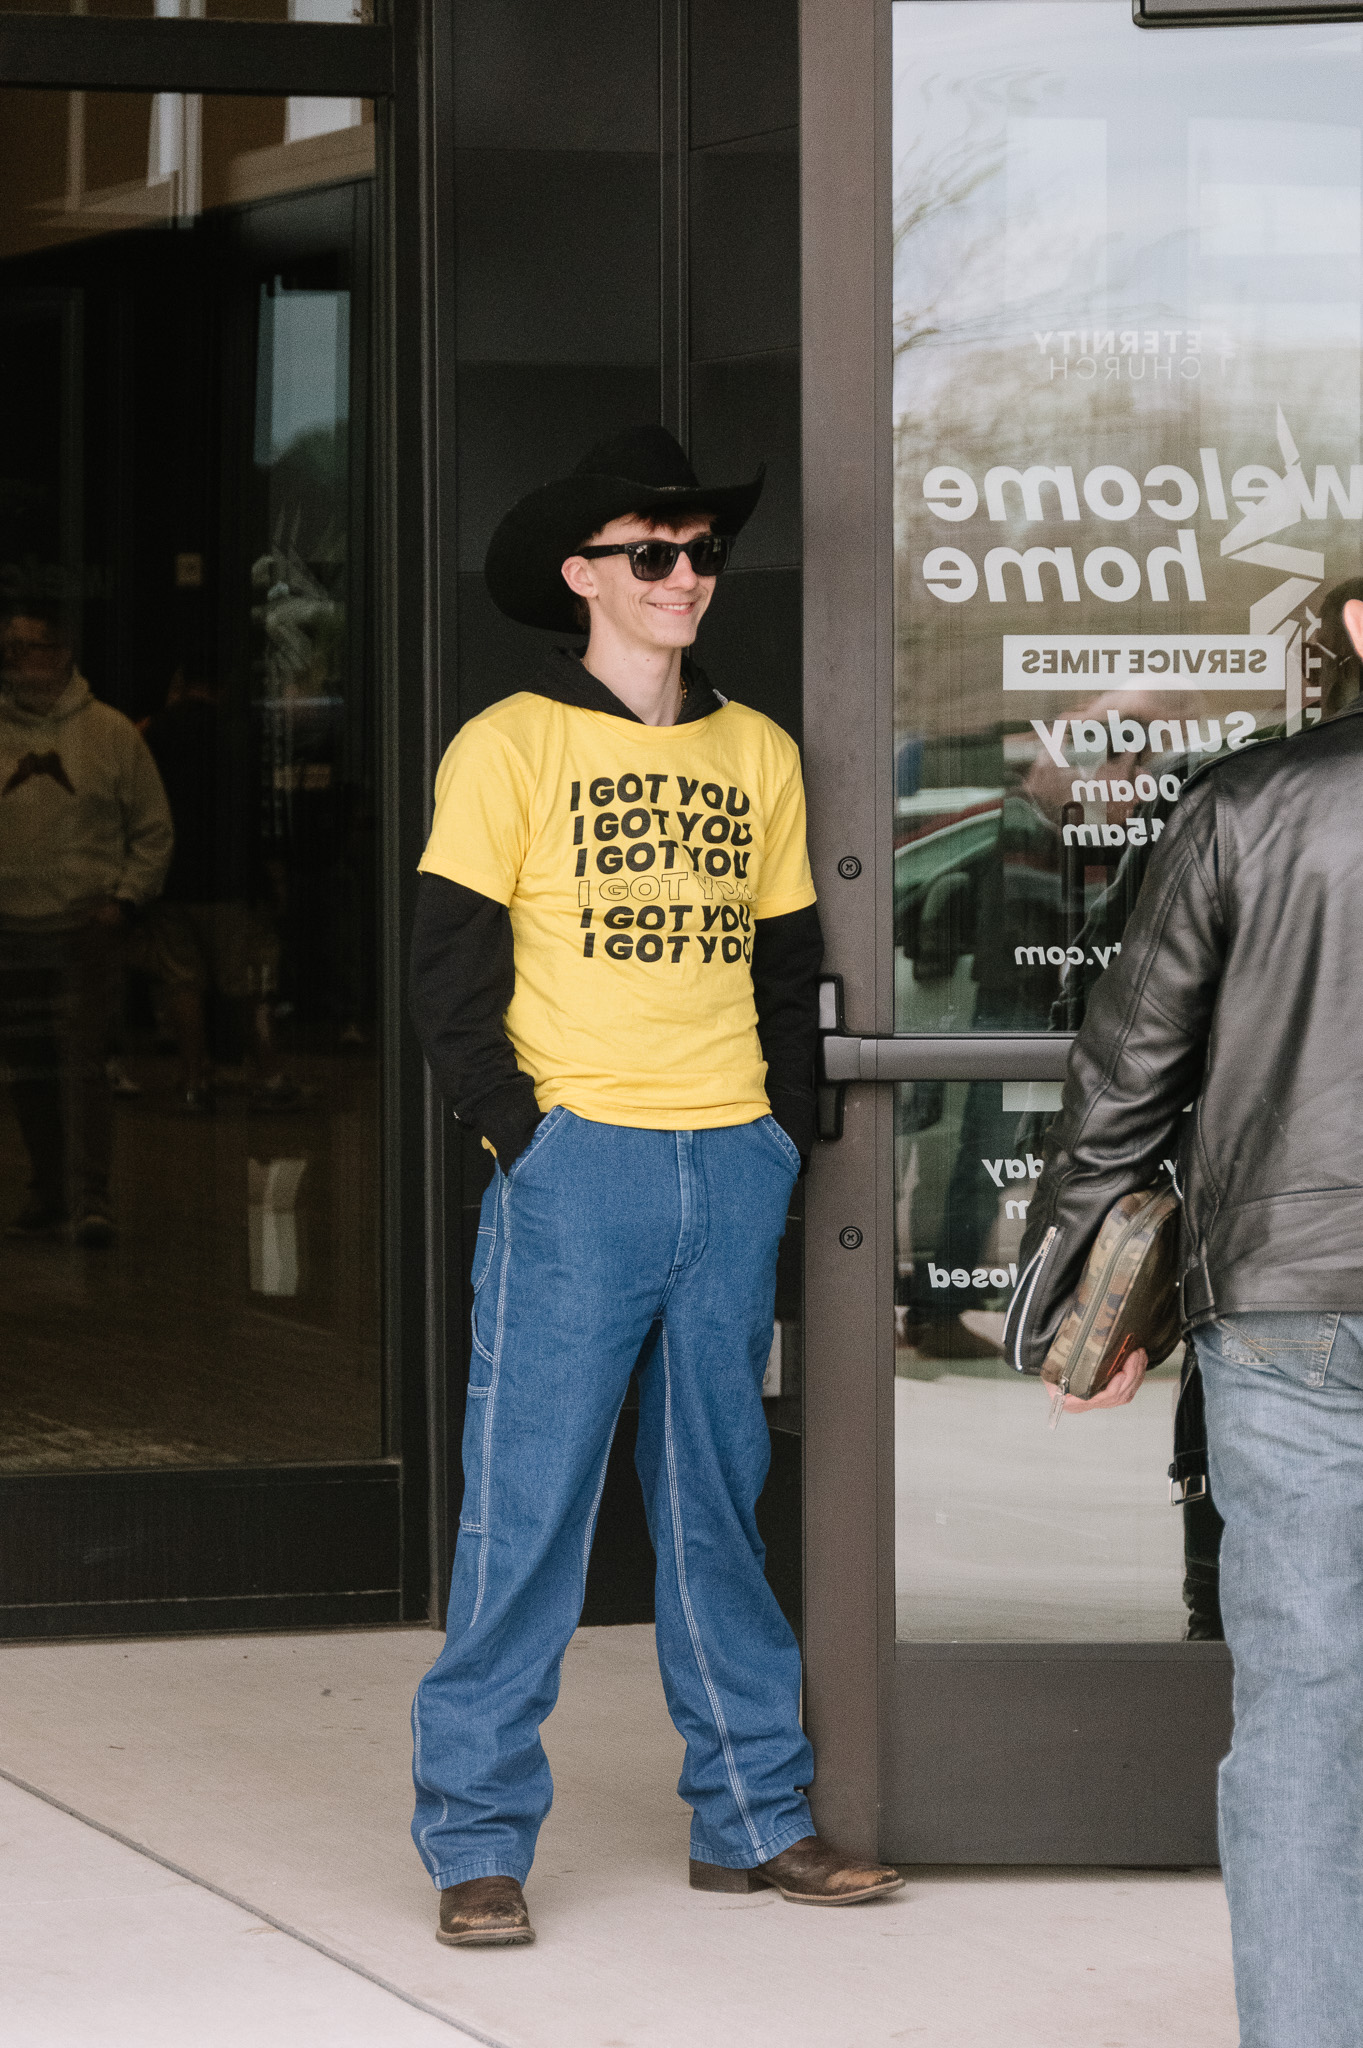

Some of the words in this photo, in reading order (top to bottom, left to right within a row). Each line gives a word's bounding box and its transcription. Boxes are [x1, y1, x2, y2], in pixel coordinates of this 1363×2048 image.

[570, 780, 581, 812] I
[589, 773, 669, 807] GOT
[676, 775, 750, 817] YOU
[573, 815, 585, 846] I
[594, 807, 669, 842] GOT
[676, 811, 753, 847] YOU
[574, 848, 588, 877] I
[596, 840, 679, 875] GOT
[682, 844, 751, 879] YOU
[578, 880, 590, 907] I
[599, 872, 688, 902] GOT
[693, 872, 758, 903] YOU
[580, 908, 594, 929] I
[603, 905, 693, 932] GOT
[700, 904, 751, 933] YOU
[583, 932, 595, 958] I
[604, 933, 690, 963] GOT
